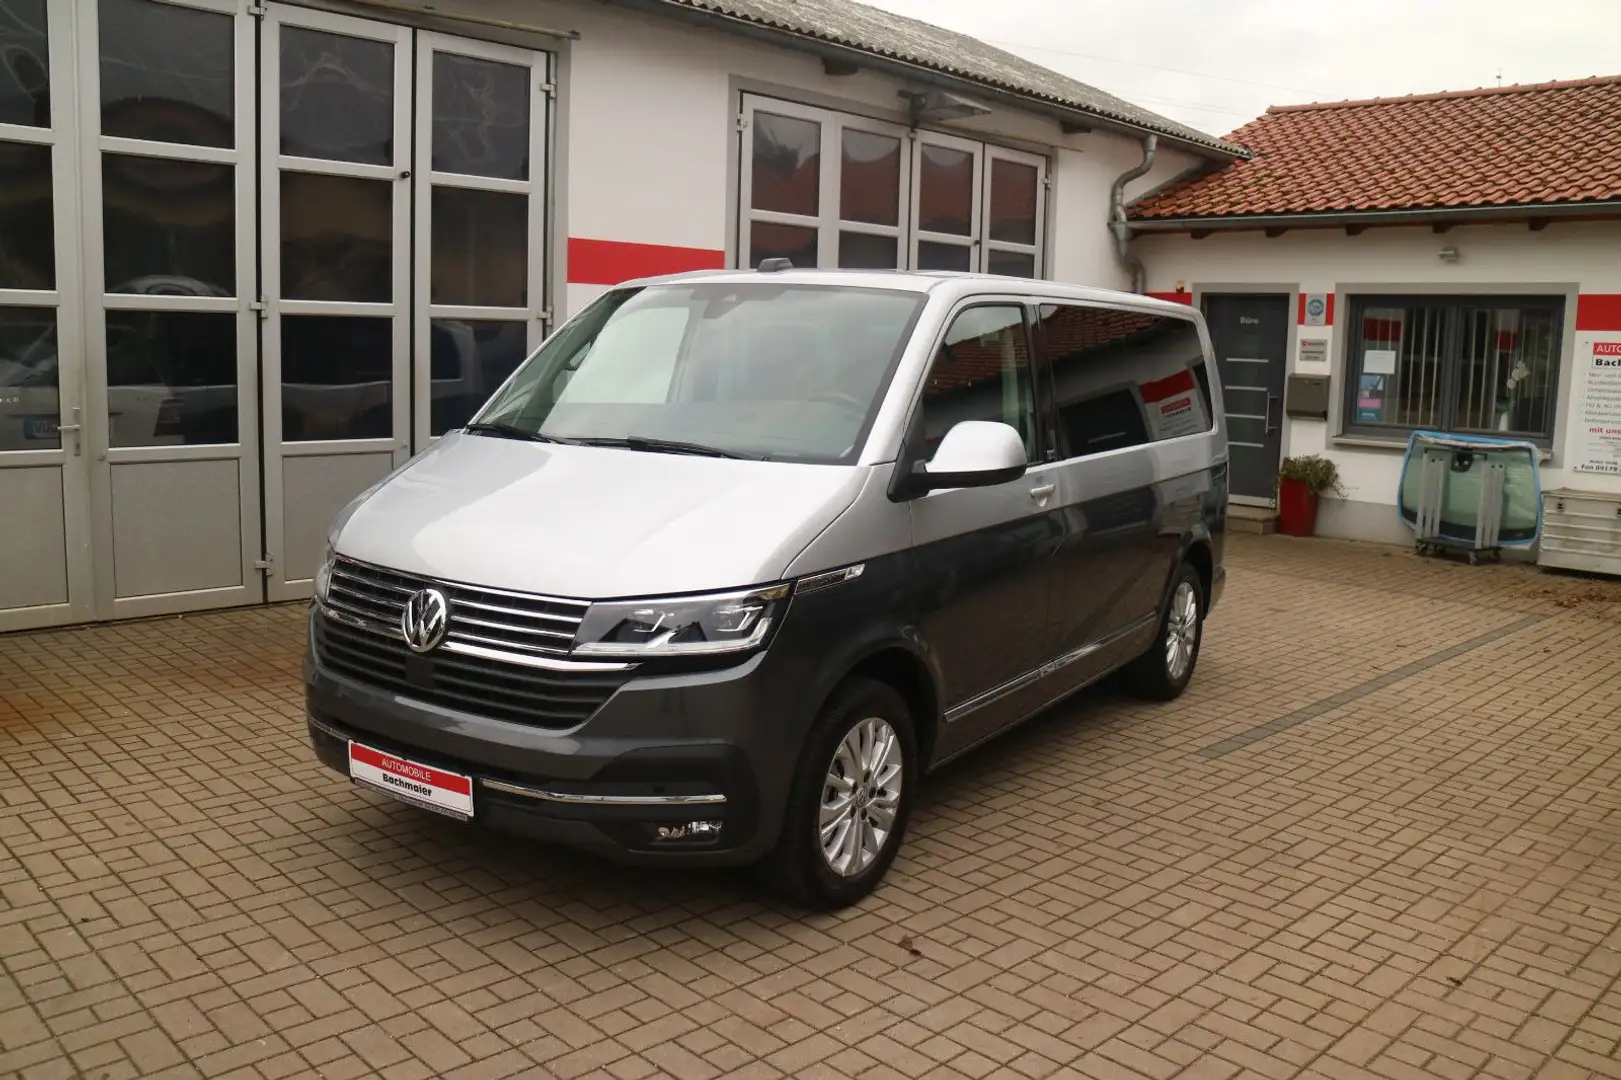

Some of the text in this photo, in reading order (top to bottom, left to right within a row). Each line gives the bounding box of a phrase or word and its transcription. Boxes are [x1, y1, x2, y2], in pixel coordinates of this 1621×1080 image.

[1240, 316, 1258, 324] Büro
[381, 757, 432, 782] AUTOMOBILE
[382, 773, 432, 797] Bachmaier
